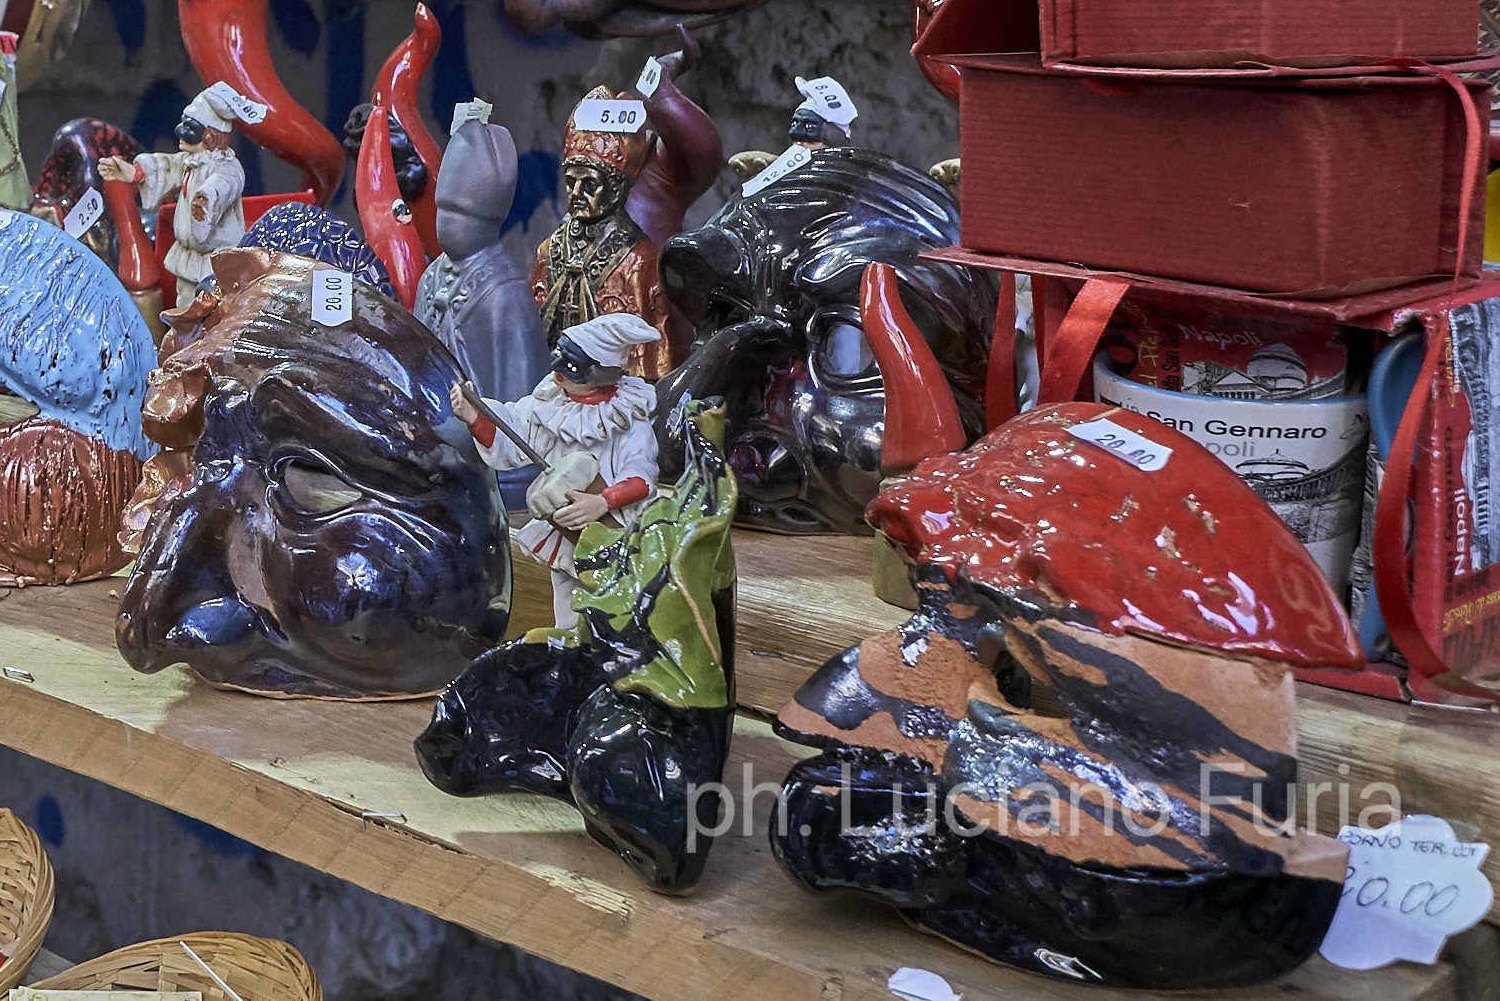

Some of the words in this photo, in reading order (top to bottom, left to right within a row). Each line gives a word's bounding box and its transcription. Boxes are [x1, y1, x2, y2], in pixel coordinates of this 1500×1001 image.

[600, 109, 638, 125] 5.00
[78, 197, 99, 226] 2.50
[325, 276, 343, 312] 20.00
[1204, 418, 1328, 440] Gennaro
[1205, 440, 1255, 457] poli
[1454, 487, 1468, 577] Napoli
